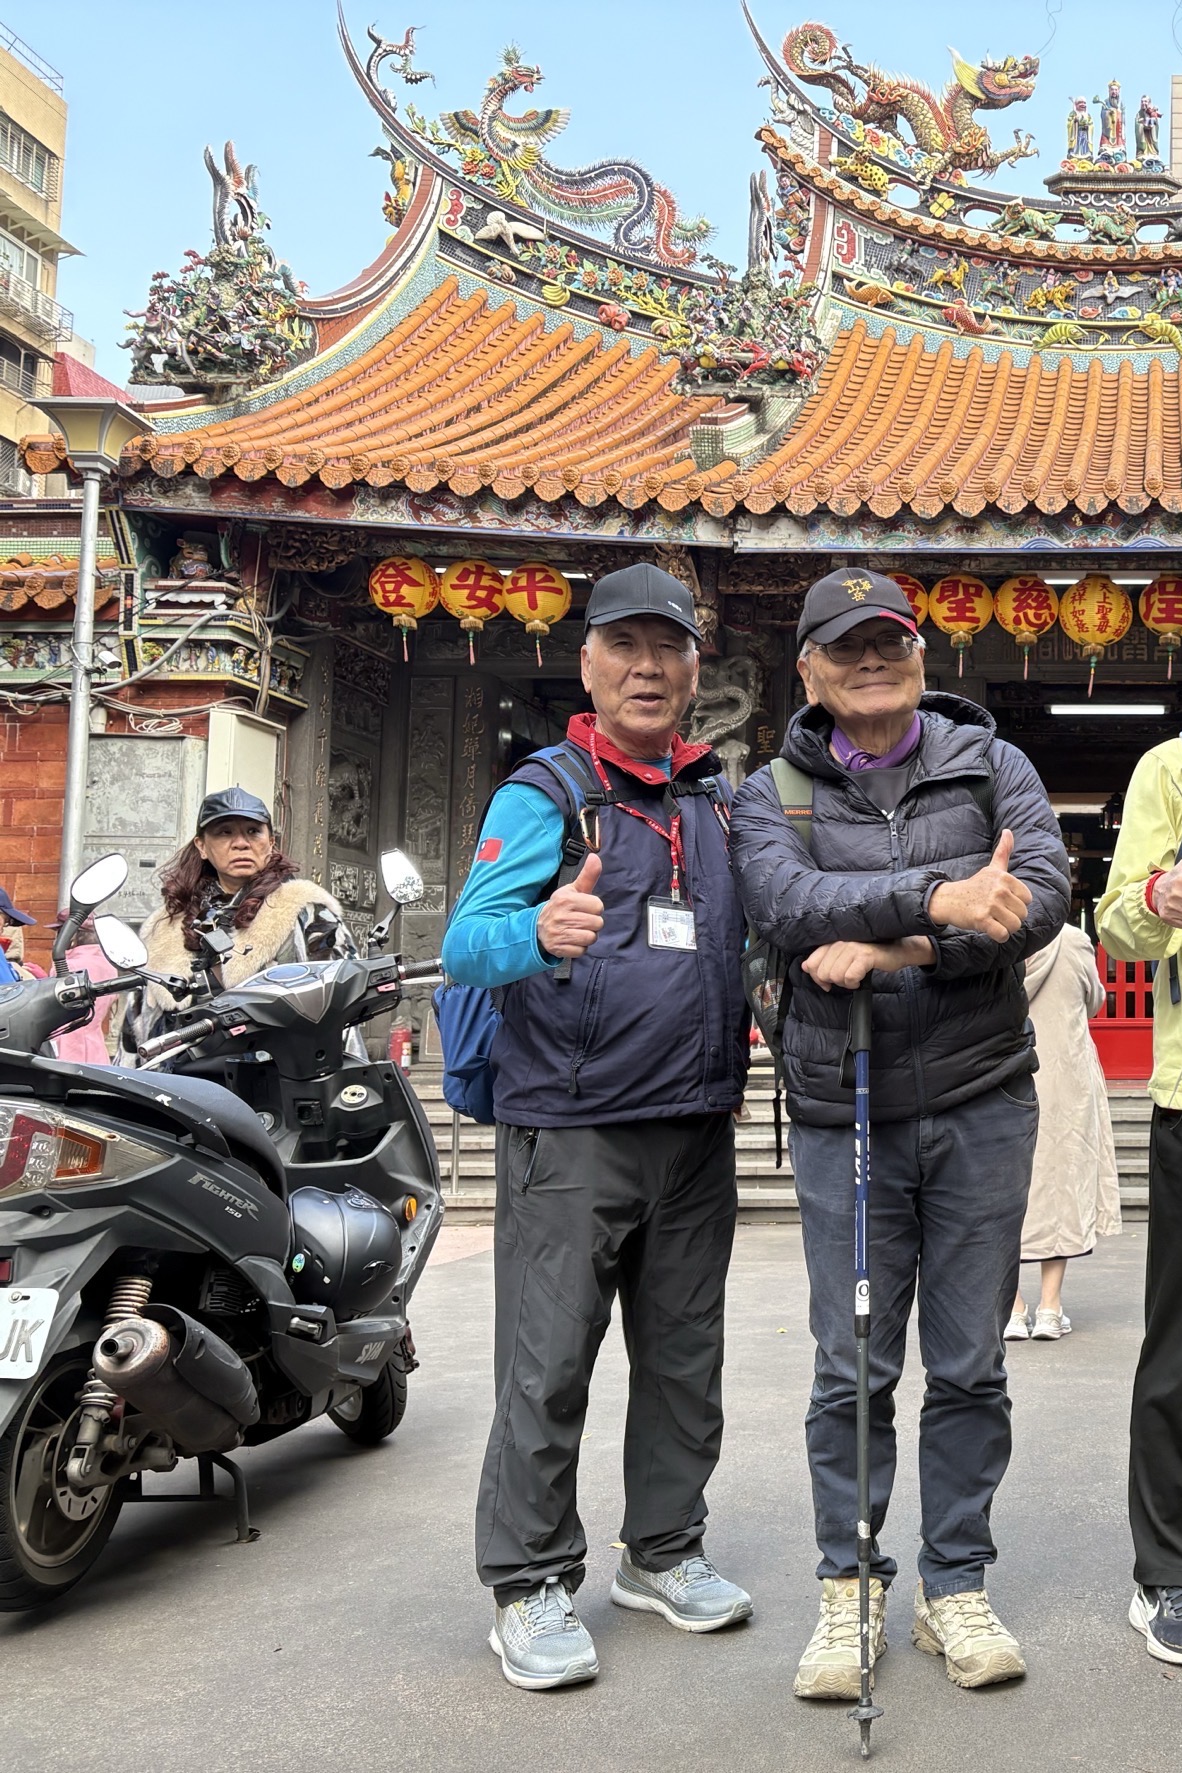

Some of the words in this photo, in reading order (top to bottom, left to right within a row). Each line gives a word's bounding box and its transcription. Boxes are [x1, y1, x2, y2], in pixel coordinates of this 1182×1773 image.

[450, 564, 504, 614] 安
[506, 567, 564, 611] 平
[935, 579, 983, 625] 聖
[1012, 579, 1053, 629] 慈
[1069, 581, 1090, 634] 吉祥如意
[1093, 582, 1113, 634] 天上聖母
[187, 1171, 259, 1221] FIGHTER
[224, 1205, 243, 1219] 150
[355, 1340, 386, 1364] SYM
